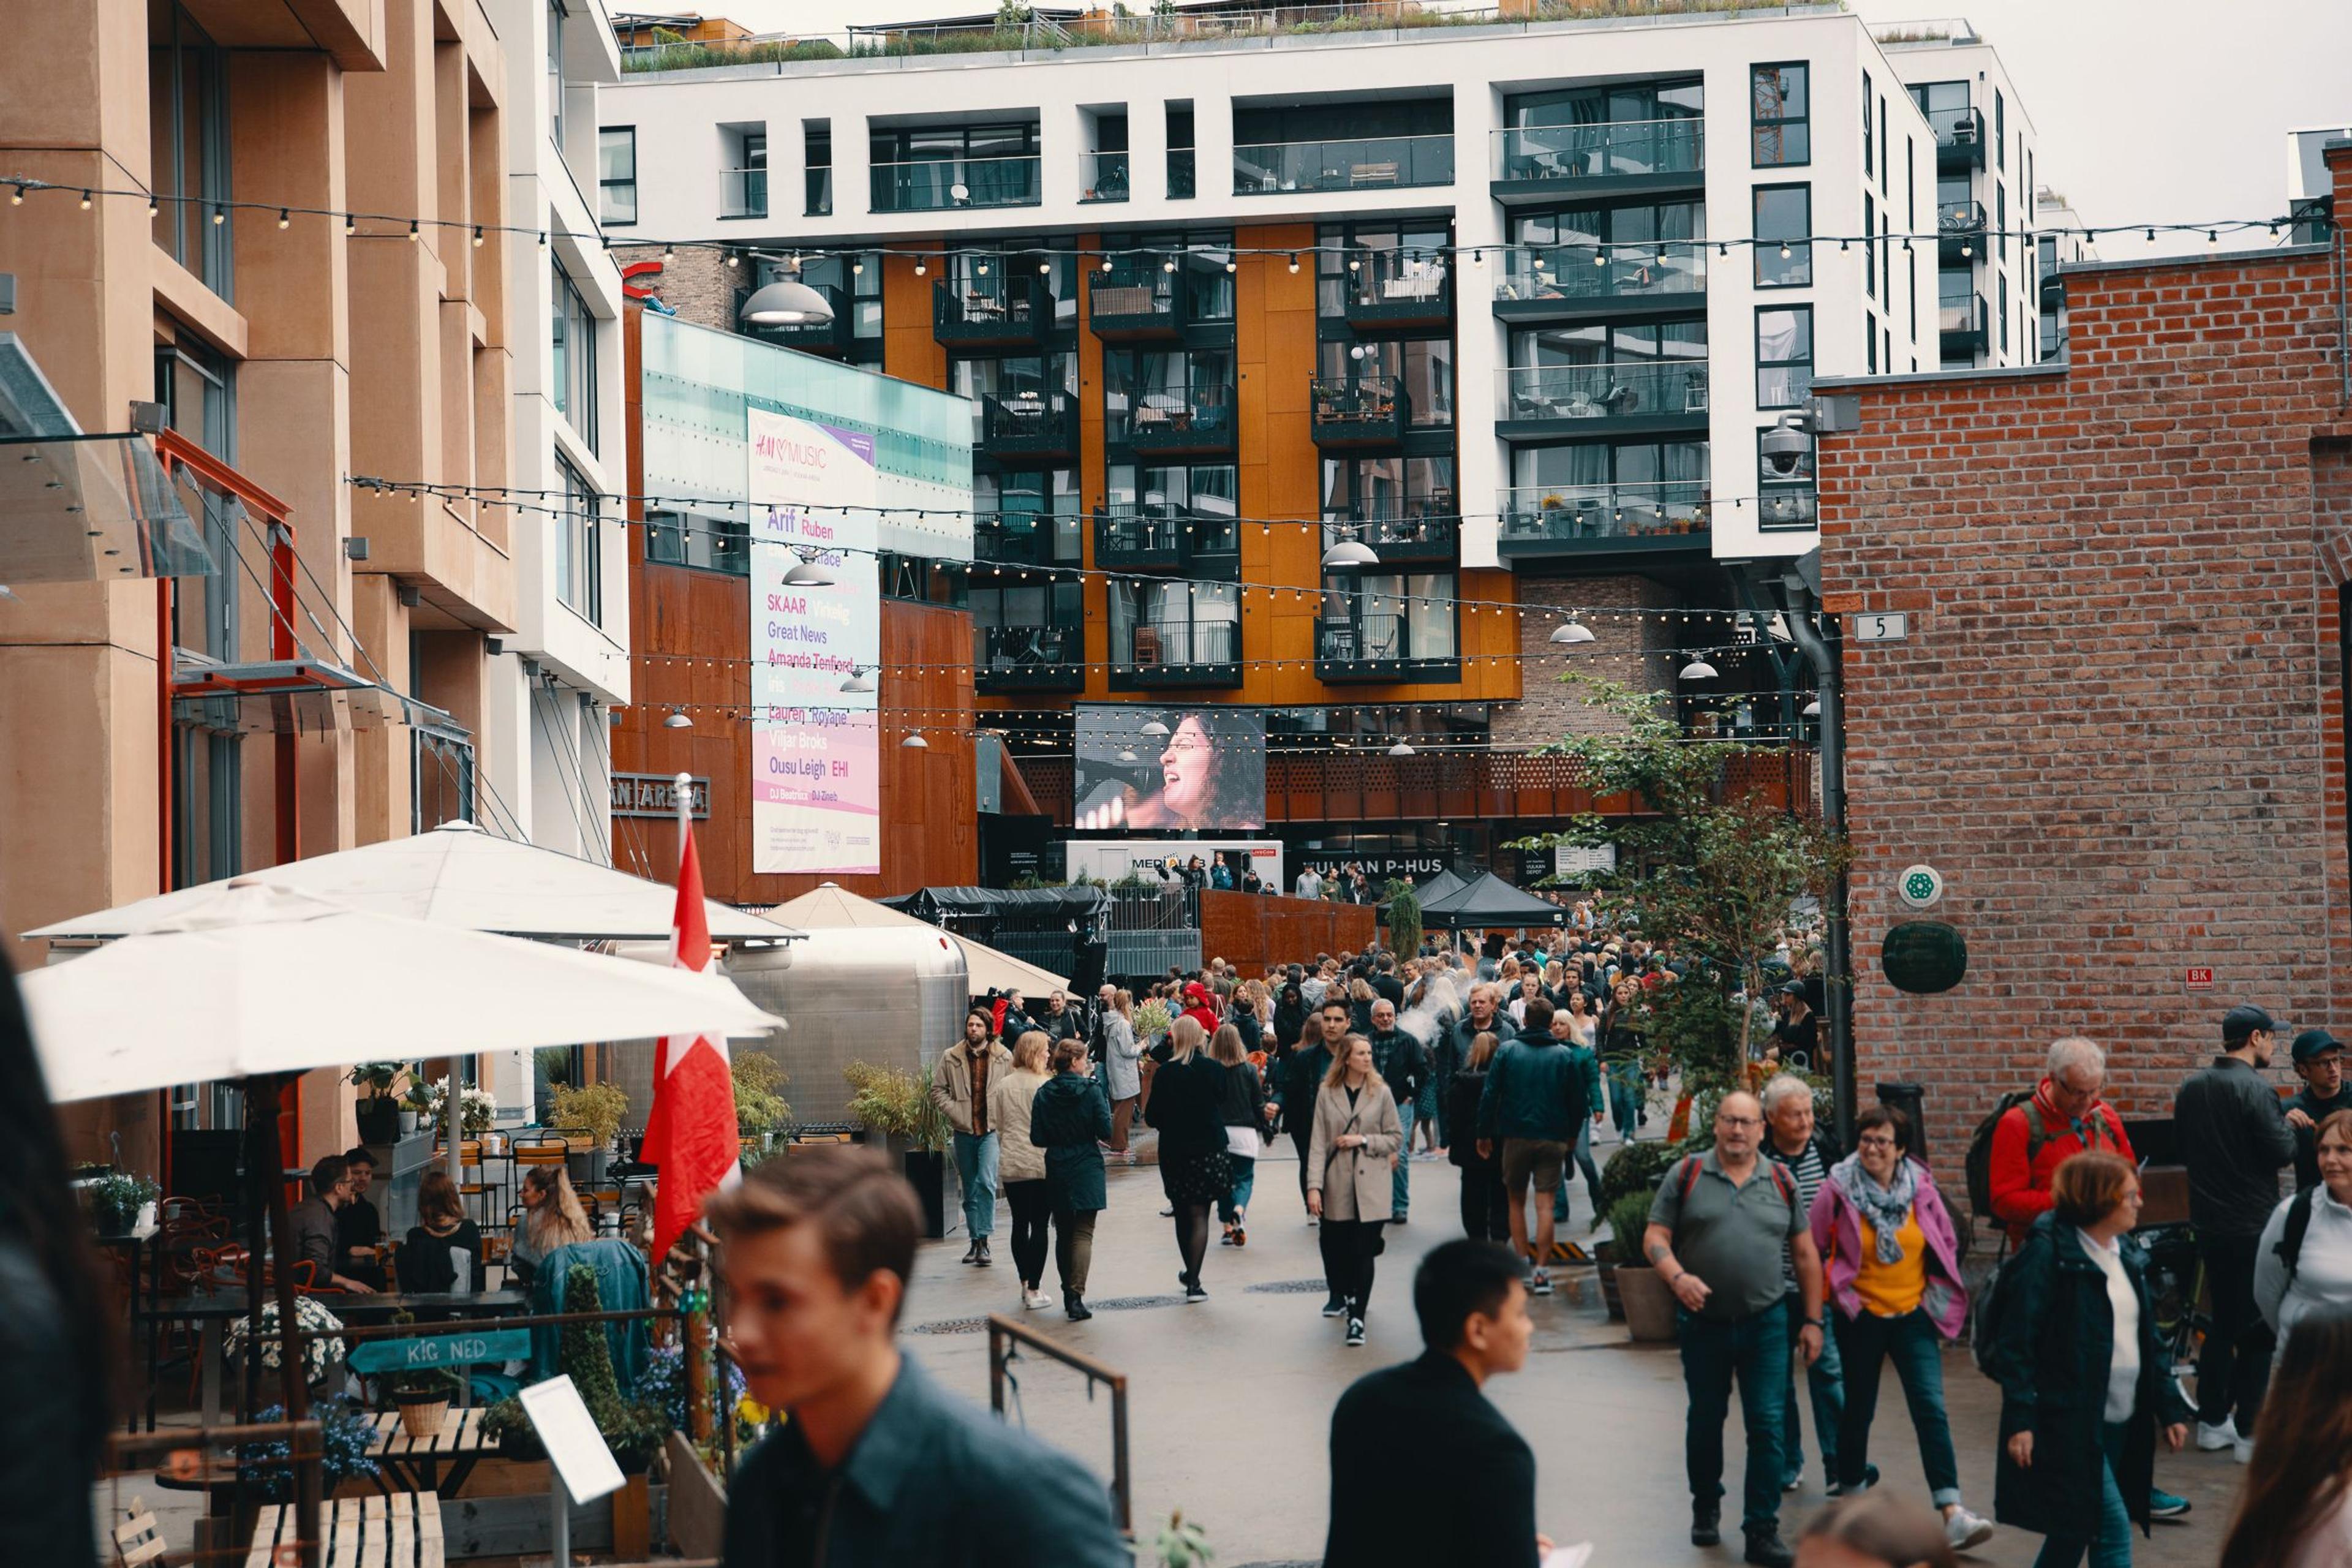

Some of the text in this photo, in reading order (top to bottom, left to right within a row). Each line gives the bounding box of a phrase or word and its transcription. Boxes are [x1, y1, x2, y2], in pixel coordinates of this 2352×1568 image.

[788, 442, 827, 469] MUSIC
[767, 506, 834, 540] Arif Ruben
[767, 593, 807, 615] SKAAR
[767, 620, 827, 645] Great News
[1876, 617, 1885, 637] 5
[767, 647, 853, 676] Amanda Tenfjord
[769, 702, 847, 728] Lauren Royane
[799, 731, 828, 750] Broks
[769, 756, 849, 781] Ousu Leigh EHI
[640, 783, 705, 809] AREA
[1132, 858, 1206, 869] MEDIALB
[1302, 859, 1442, 875] UKAN P-HUS
[2192, 970, 2208, 981] BK
[450, 1339, 487, 1361] NED
